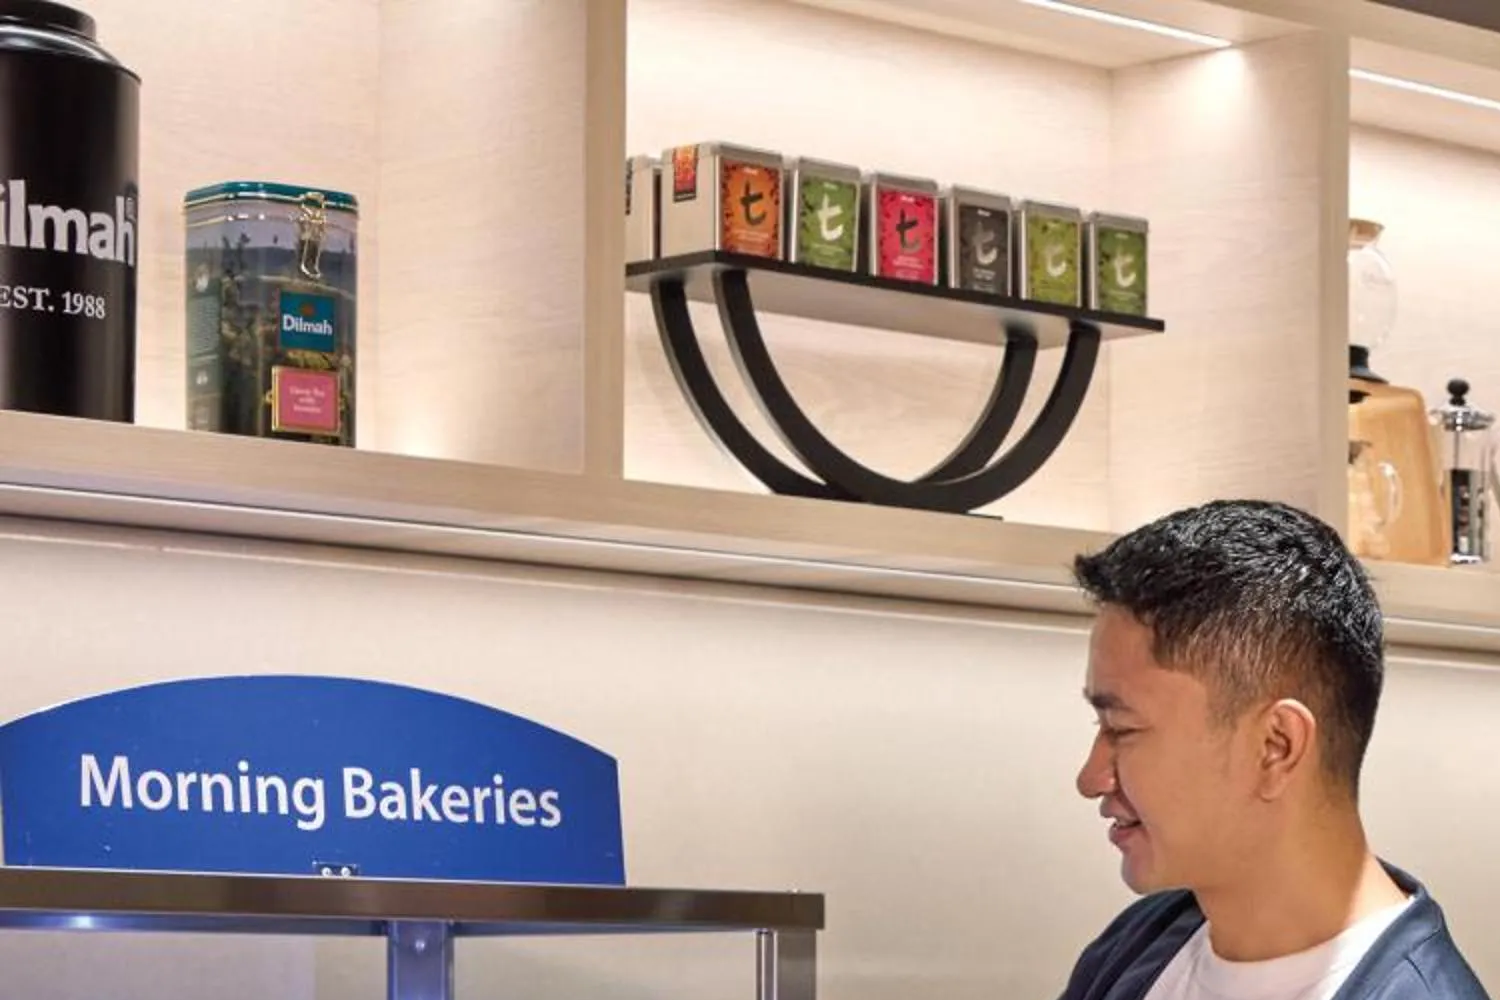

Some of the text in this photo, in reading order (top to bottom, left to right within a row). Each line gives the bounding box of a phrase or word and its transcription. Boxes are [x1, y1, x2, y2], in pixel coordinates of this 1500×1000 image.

[0, 285, 106, 319] EST. 1988
[282, 313, 333, 336] Dilmah
[80, 754, 561, 830] Morning Bakeries
